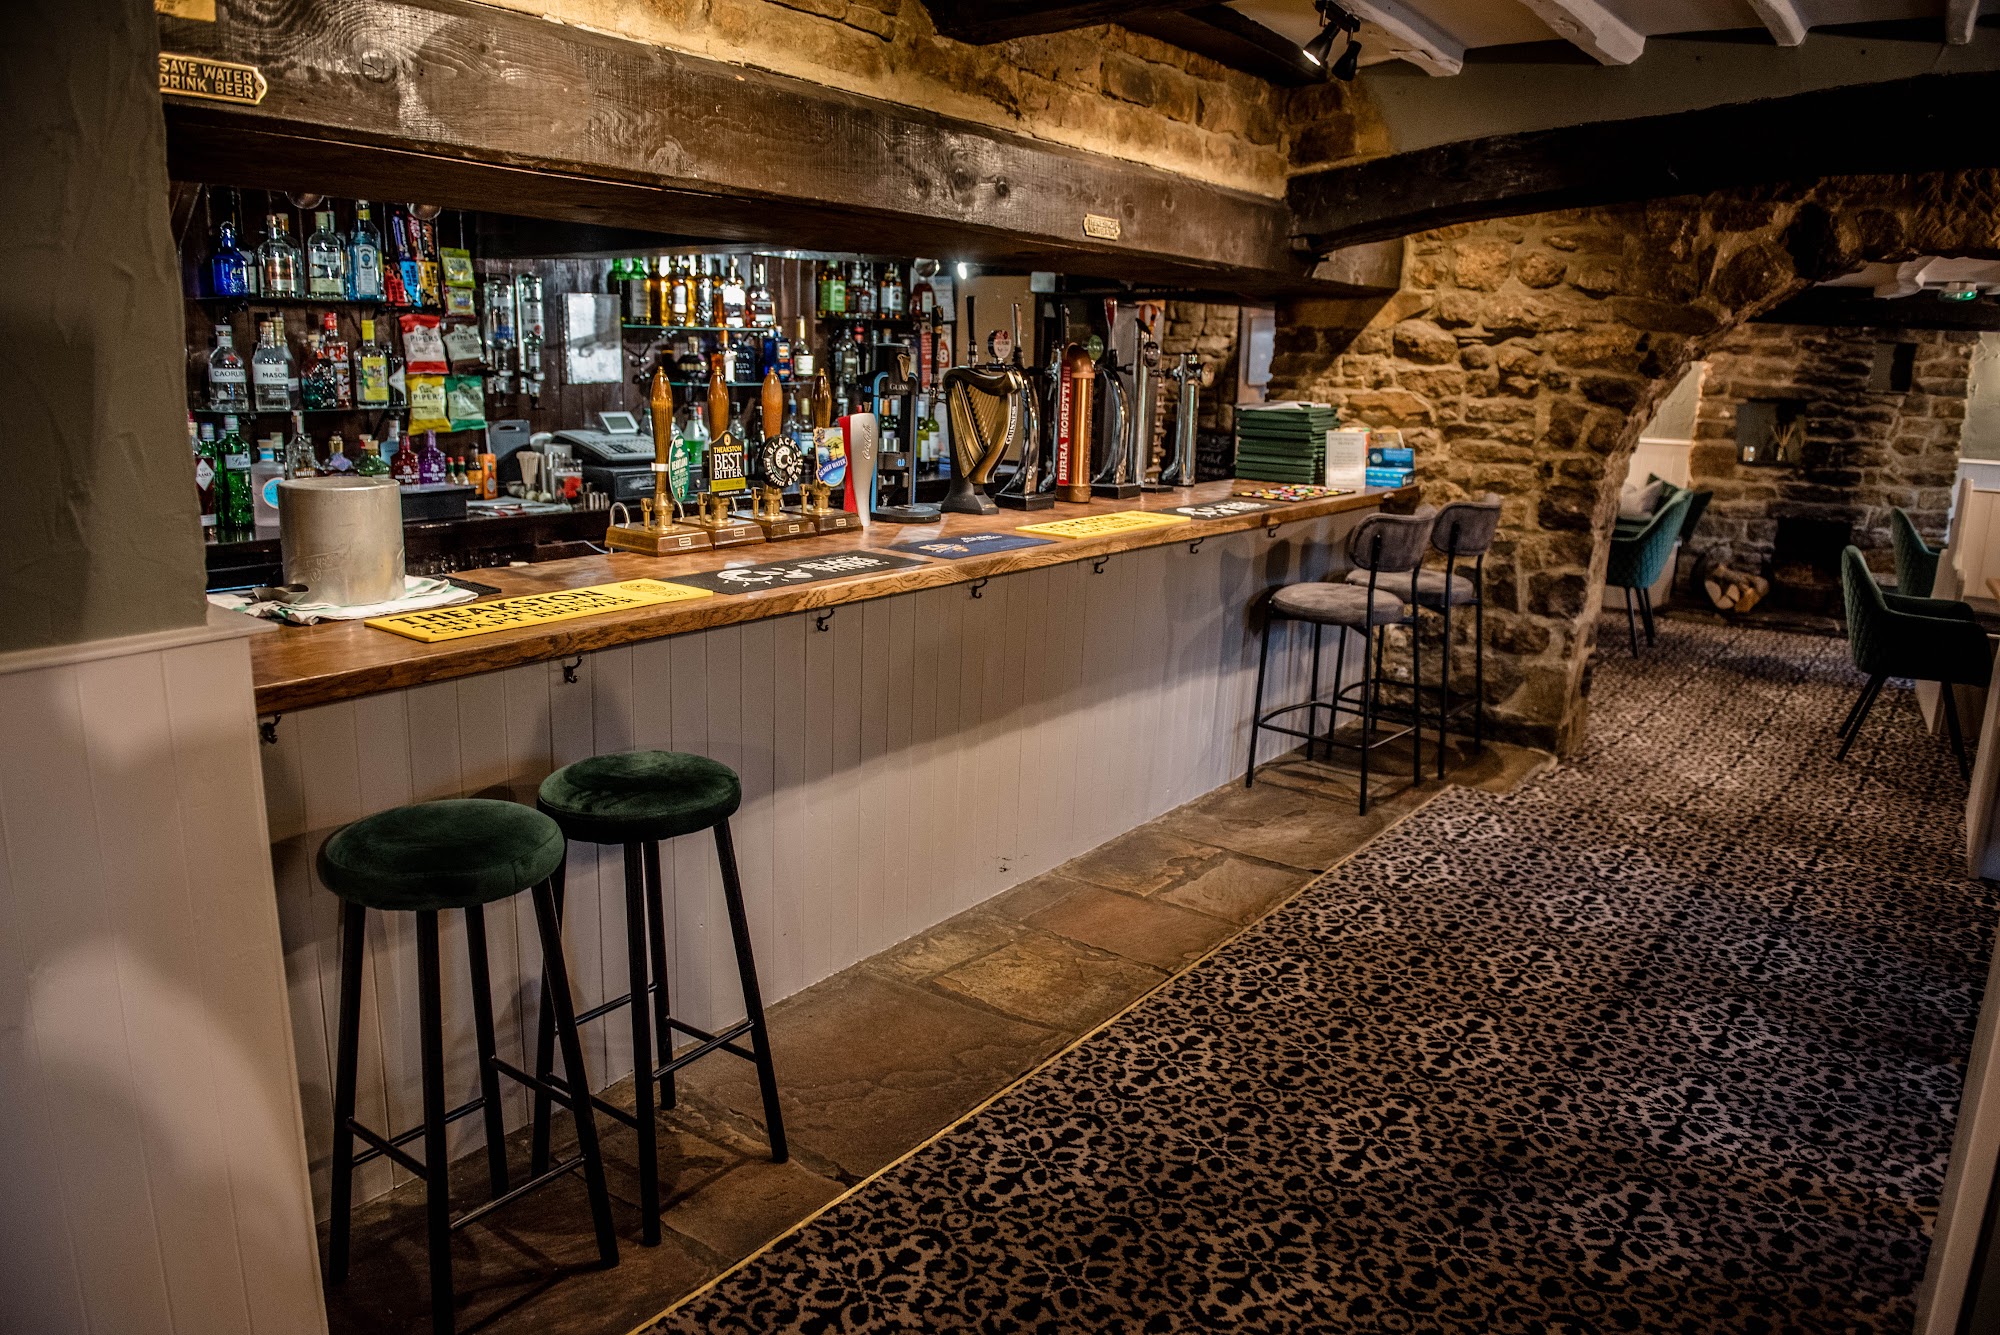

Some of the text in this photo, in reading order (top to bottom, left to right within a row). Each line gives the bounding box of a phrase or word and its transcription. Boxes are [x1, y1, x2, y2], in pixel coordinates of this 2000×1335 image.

[159, 58, 253, 84] SAVE WATER
[160, 74, 254, 99] DRINK BEER
[1006, 405, 1017, 444] GUINNESS
[1061, 382, 1070, 438] MORETTI
[713, 445, 742, 453] THEAKSTON
[714, 452, 742, 470] BEST
[767, 436, 804, 486] BLACK SHEEP
[1060, 443, 1068, 480] BIRRA
[714, 469, 743, 479] BITTER
[390, 590, 601, 623] THEAKSTON
[412, 595, 624, 630] THE ORIGINAL
[431, 598, 641, 635] CRAFT BREWER
